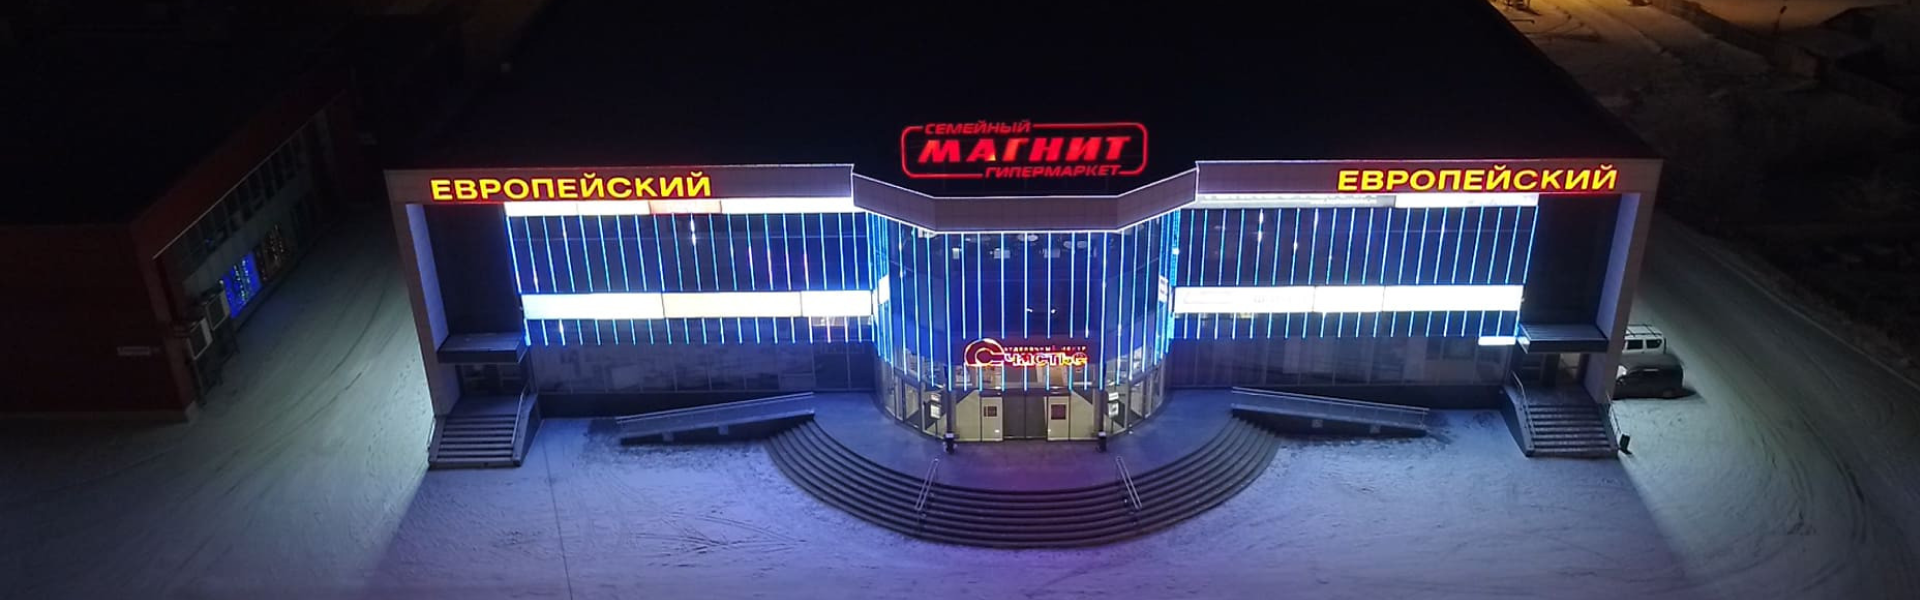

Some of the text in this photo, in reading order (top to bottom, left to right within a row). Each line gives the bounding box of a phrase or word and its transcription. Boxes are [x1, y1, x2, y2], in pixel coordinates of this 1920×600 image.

[924, 119, 1031, 135] СЕМЕЙНЫЙ
[917, 136, 1131, 163] МАГНИТ
[984, 164, 1122, 179] ГИПЕРМАРКЕТ
[1337, 164, 1618, 191] ЕВРОПЕЙСКИЙ
[430, 171, 712, 200] ЕВРОПЕЙСКИЙ
